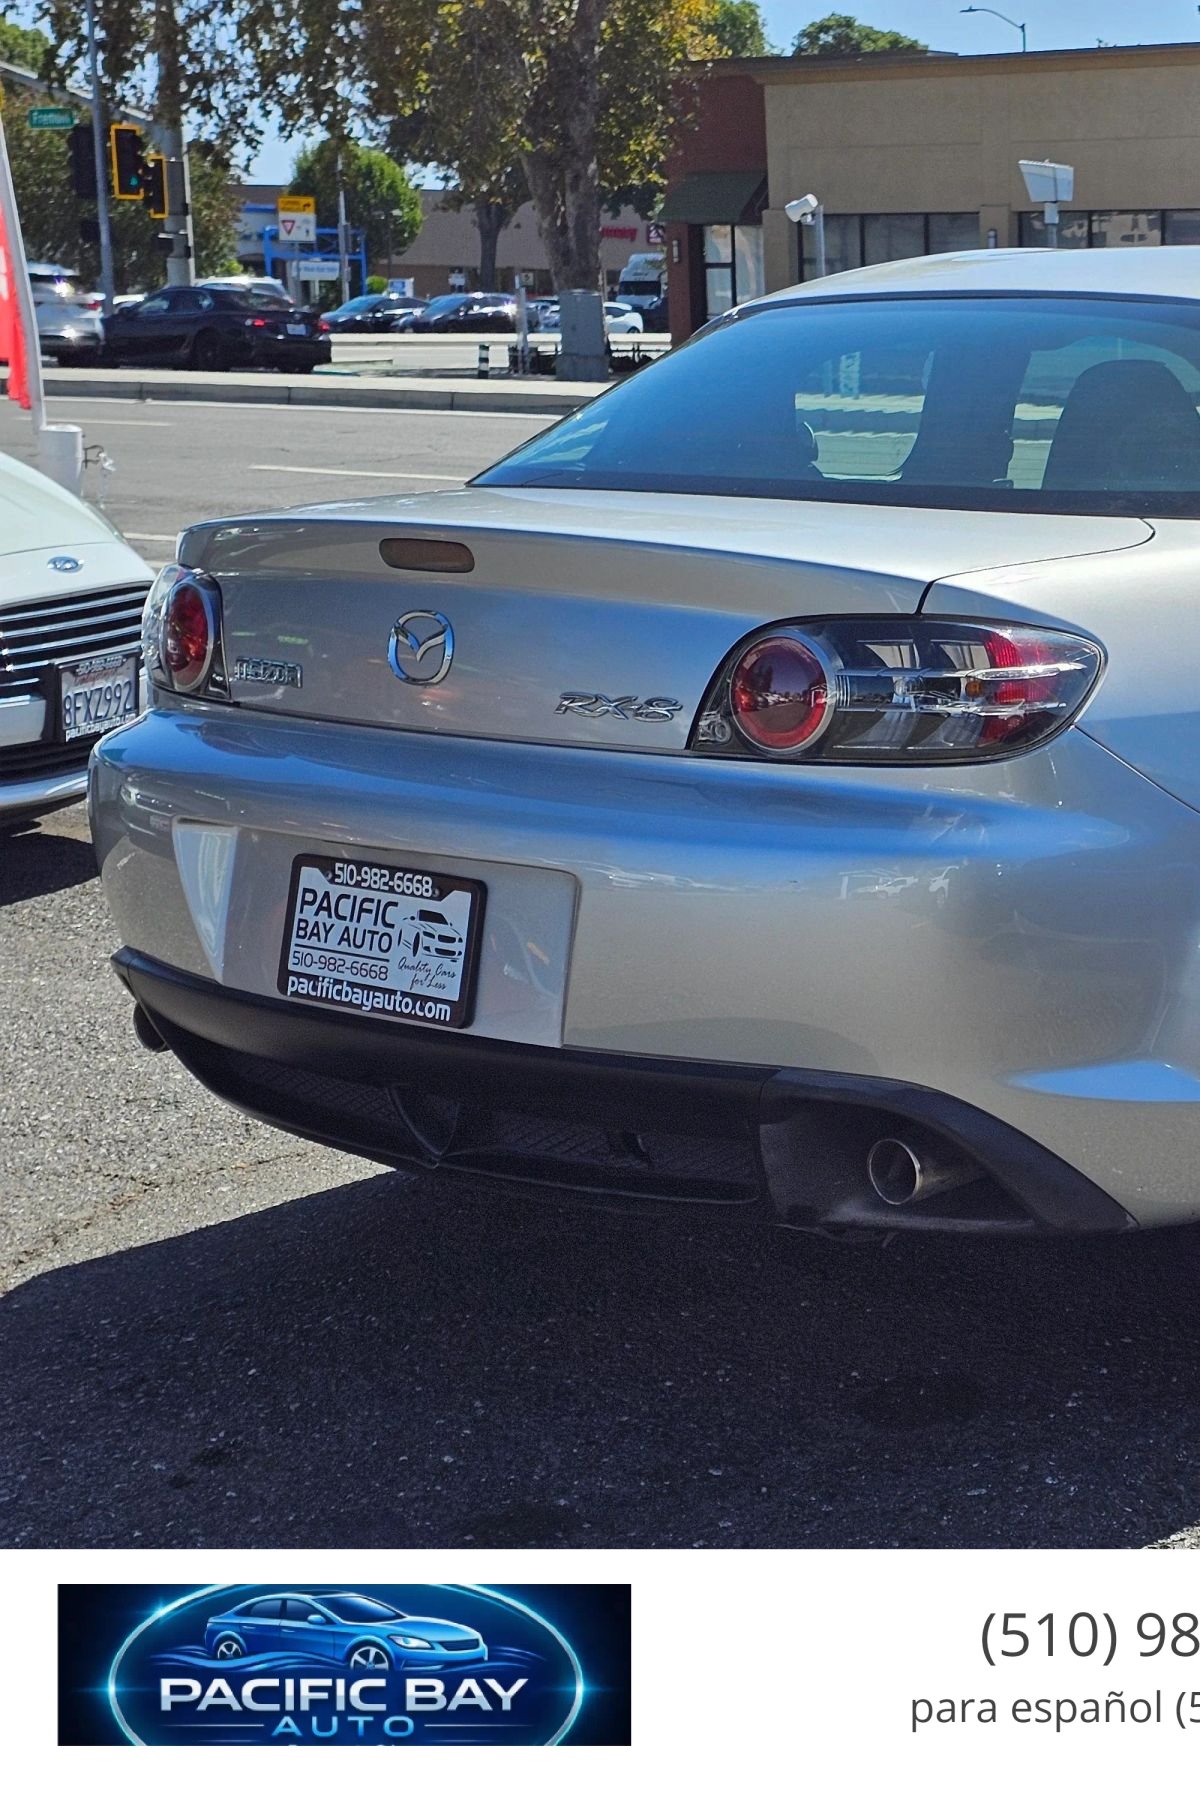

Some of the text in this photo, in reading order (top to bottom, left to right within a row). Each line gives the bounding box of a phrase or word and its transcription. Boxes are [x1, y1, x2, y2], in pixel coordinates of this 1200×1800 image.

[64, 680, 133, 727] 8FXZ992
[554, 691, 684, 723] RX-8
[334, 863, 433, 897] 510-982-6668
[299, 887, 399, 929] PACIFIC
[296, 918, 393, 953] BAY AUTO
[292, 950, 389, 981] 510-982-6668
[398, 956, 456, 981] Quality Cars
[410, 973, 446, 991] for Less
[287, 975, 450, 1021] pacificbayauto.com
